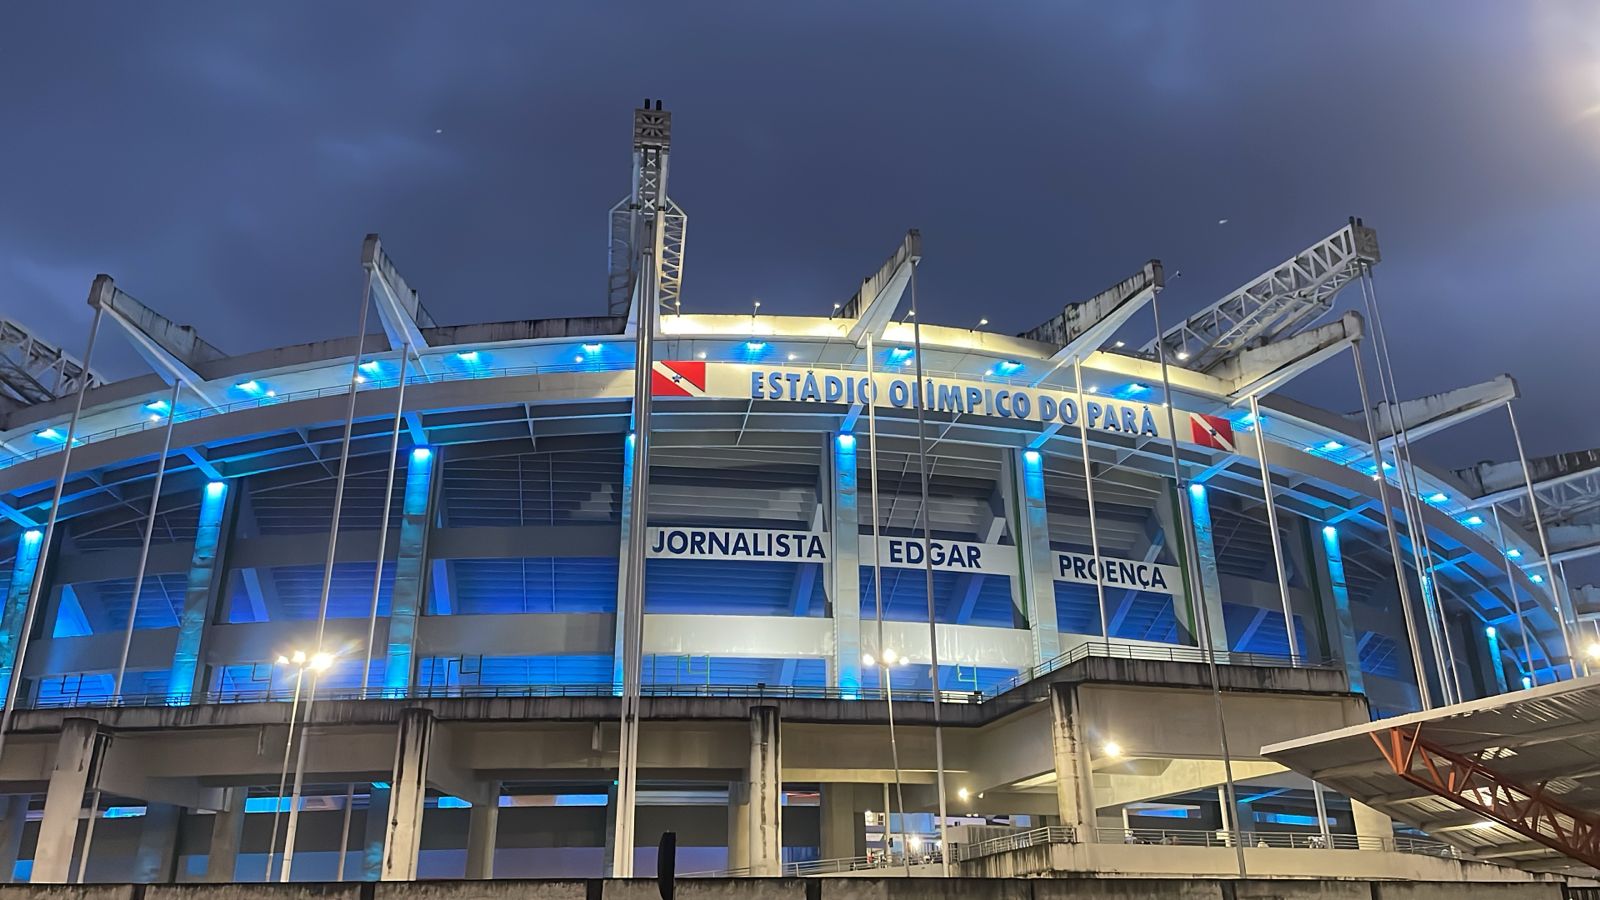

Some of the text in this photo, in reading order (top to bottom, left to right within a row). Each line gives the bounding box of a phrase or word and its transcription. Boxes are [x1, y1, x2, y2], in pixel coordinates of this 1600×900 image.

[751, 369, 877, 404] ESTÁDIO
[1039, 395, 1078, 425] DO
[1087, 404, 1158, 437] PARÁ
[652, 530, 826, 559] JORNALISTA
[889, 540, 981, 568] EDGAR
[1059, 554, 1167, 589] PROENÇA
